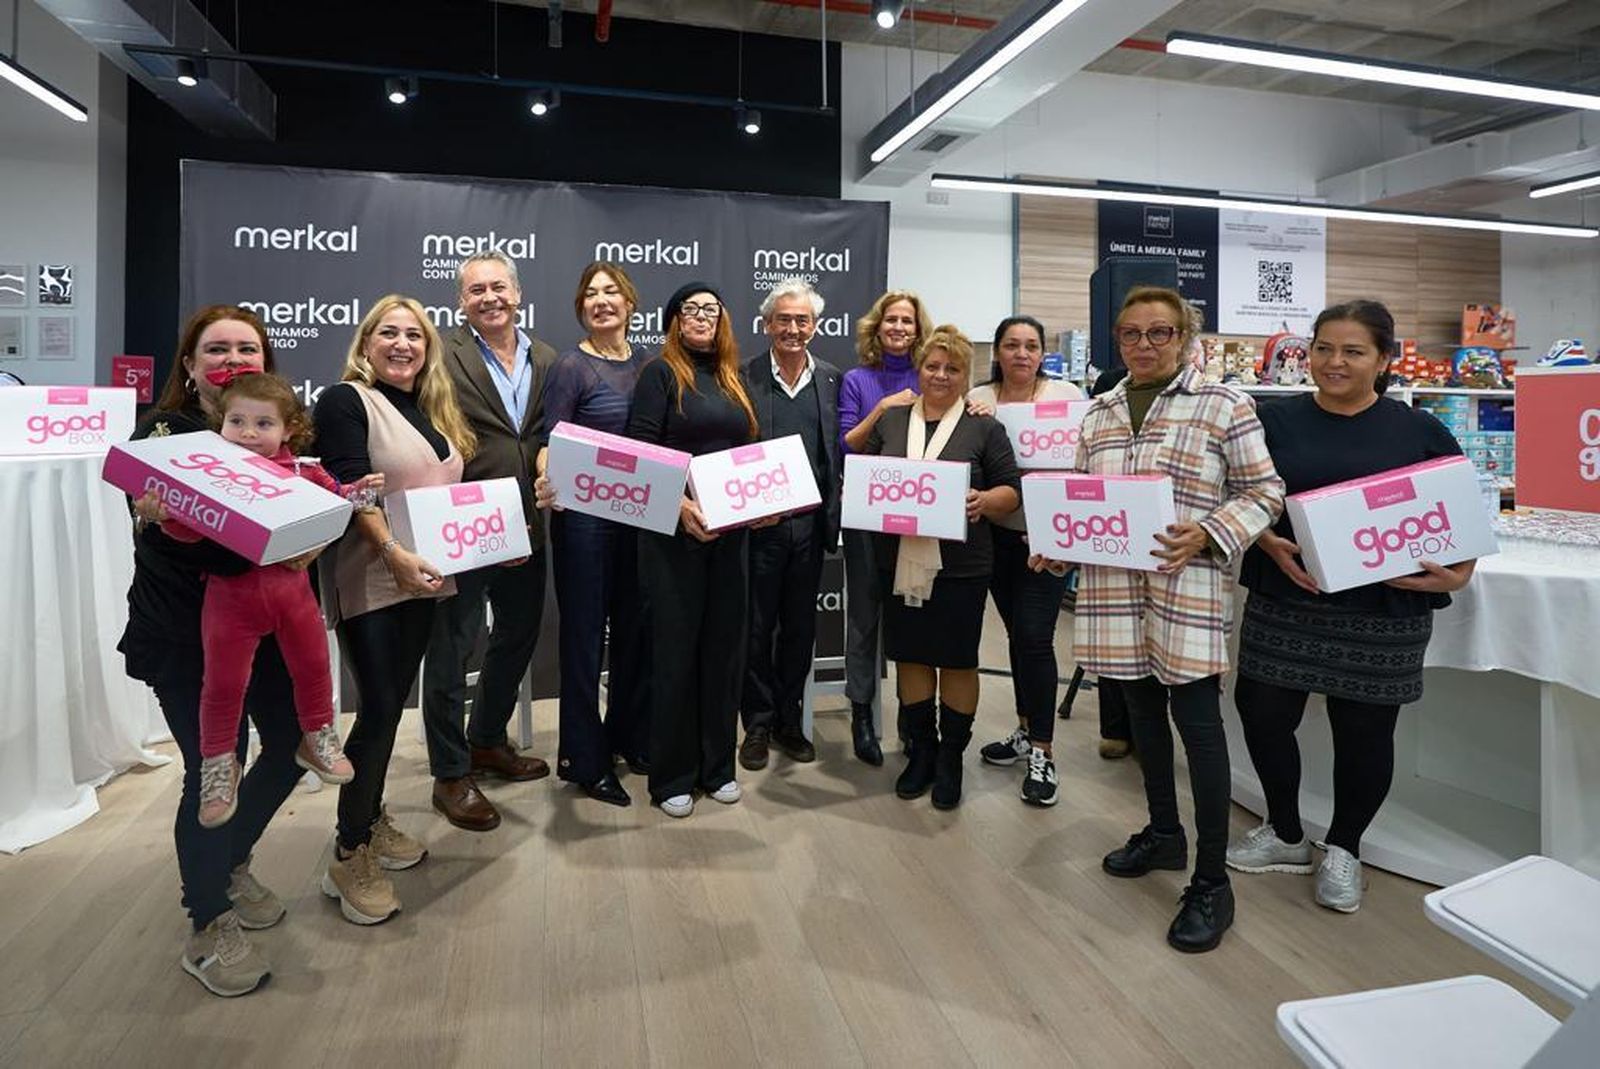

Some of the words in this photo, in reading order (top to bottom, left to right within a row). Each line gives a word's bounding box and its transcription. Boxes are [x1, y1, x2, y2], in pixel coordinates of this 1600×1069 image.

[234, 224, 358, 252] merkal
[422, 231, 536, 259] merkal
[1110, 241, 1136, 253] ÚNETE
[1137, 245, 1143, 253] A
[1145, 245, 1176, 256] MERKAL
[1177, 248, 1207, 258] FAMILY
[422, 259, 461, 269] CAMIN
[594, 239, 699, 265] merkal
[753, 247, 850, 271] merkal
[422, 269, 456, 279] CONT
[265, 327, 319, 338] INAMOS
[268, 338, 298, 349] TIGO
[626, 335, 667, 345] NAMOS
[27, 410, 106, 444] good
[68, 432, 105, 445] BOX
[1051, 446, 1074, 459] BO
[169, 453, 295, 500] good
[869, 466, 902, 483] BOX
[210, 479, 264, 504] BOX
[574, 472, 652, 505] good
[724, 463, 790, 511] good
[761, 488, 797, 505] BOX
[868, 472, 937, 505] good
[144, 475, 229, 533] merkal
[609, 499, 649, 518] BOX
[441, 507, 506, 559] good
[1051, 509, 1129, 549] good
[1353, 500, 1452, 570] good
[478, 538, 509, 555] BOX
[1091, 536, 1132, 556] BOX
[1407, 532, 1457, 560] BOX
